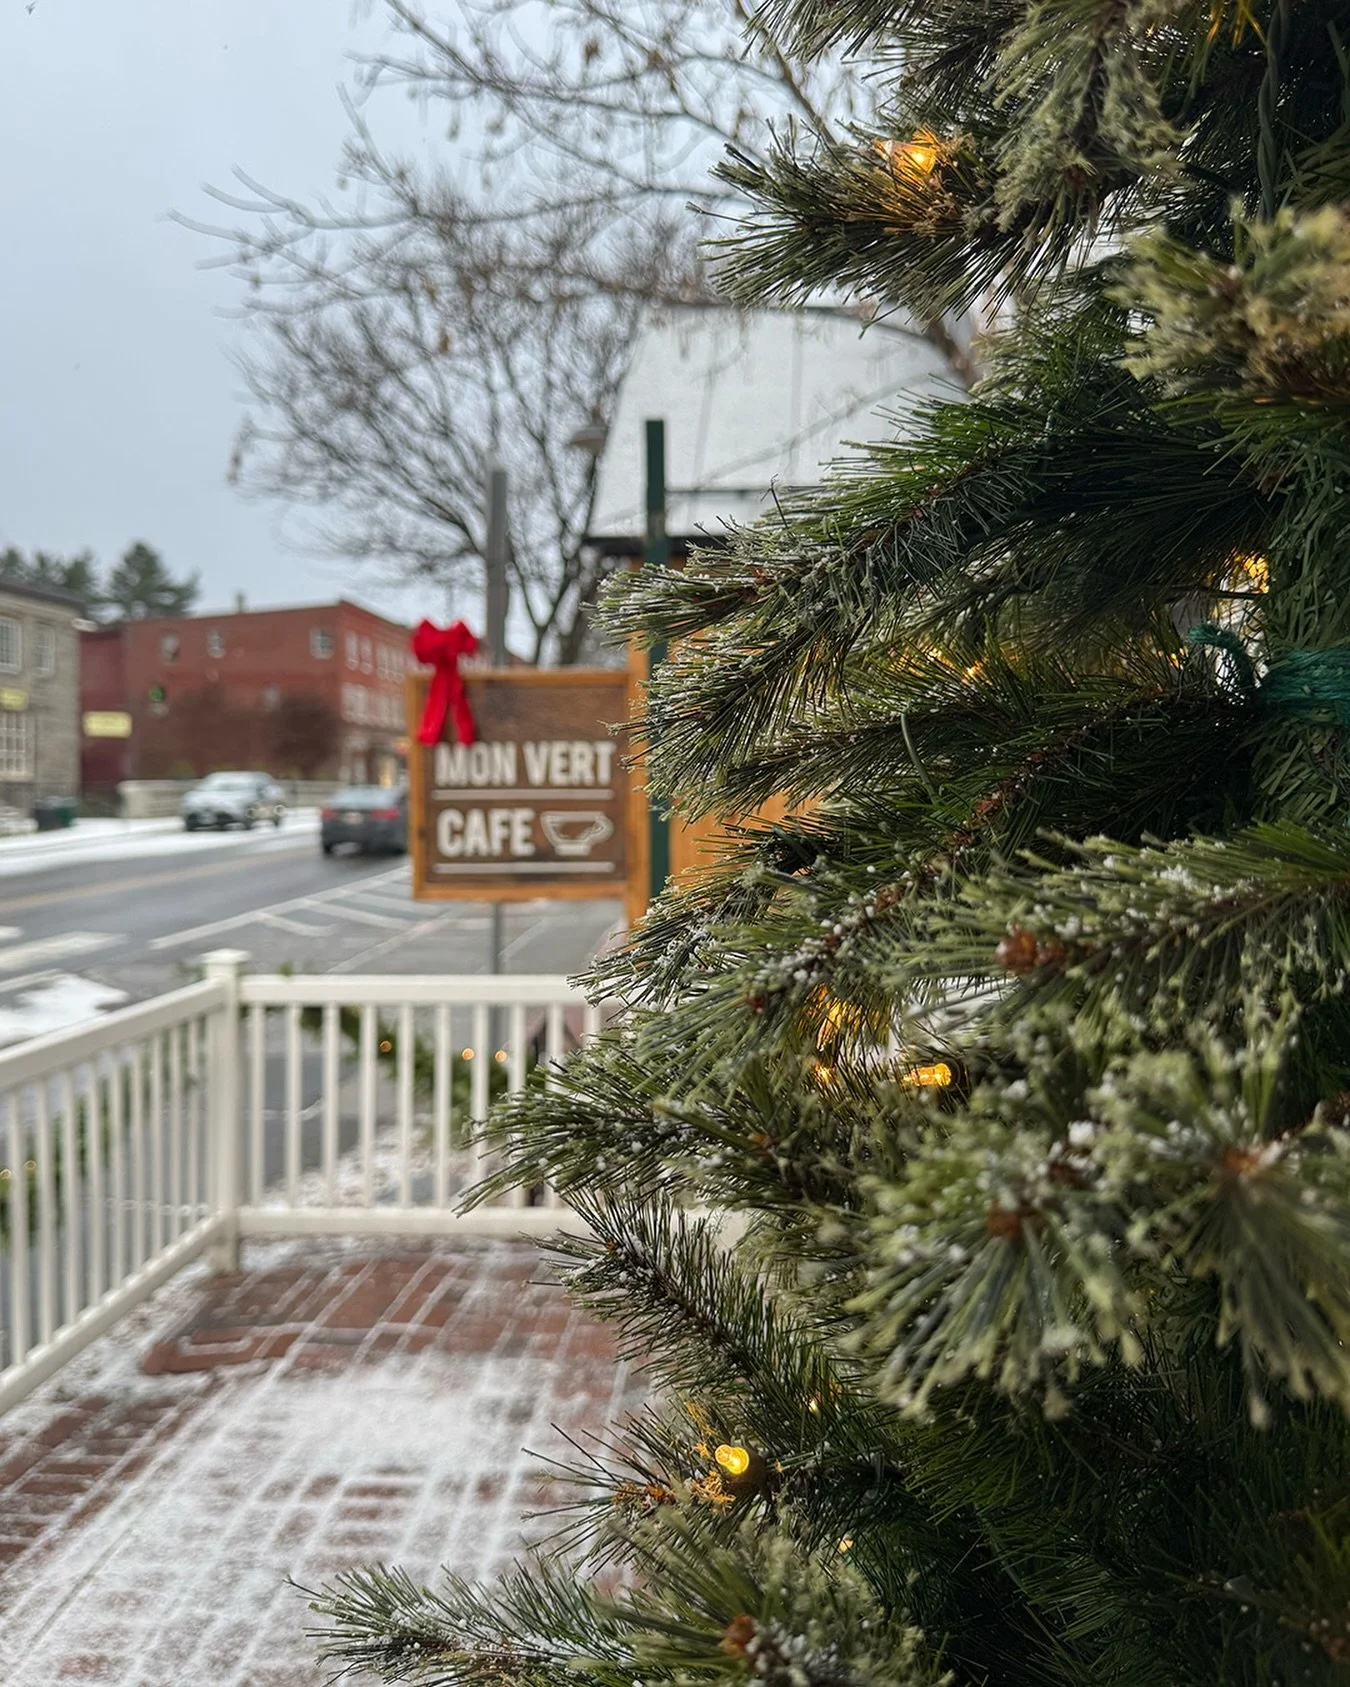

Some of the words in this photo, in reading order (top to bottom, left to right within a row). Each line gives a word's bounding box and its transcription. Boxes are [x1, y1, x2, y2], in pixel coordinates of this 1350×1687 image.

[434, 741, 517, 787] MON
[523, 740, 616, 787] VERT
[436, 807, 536, 858] CAFE
